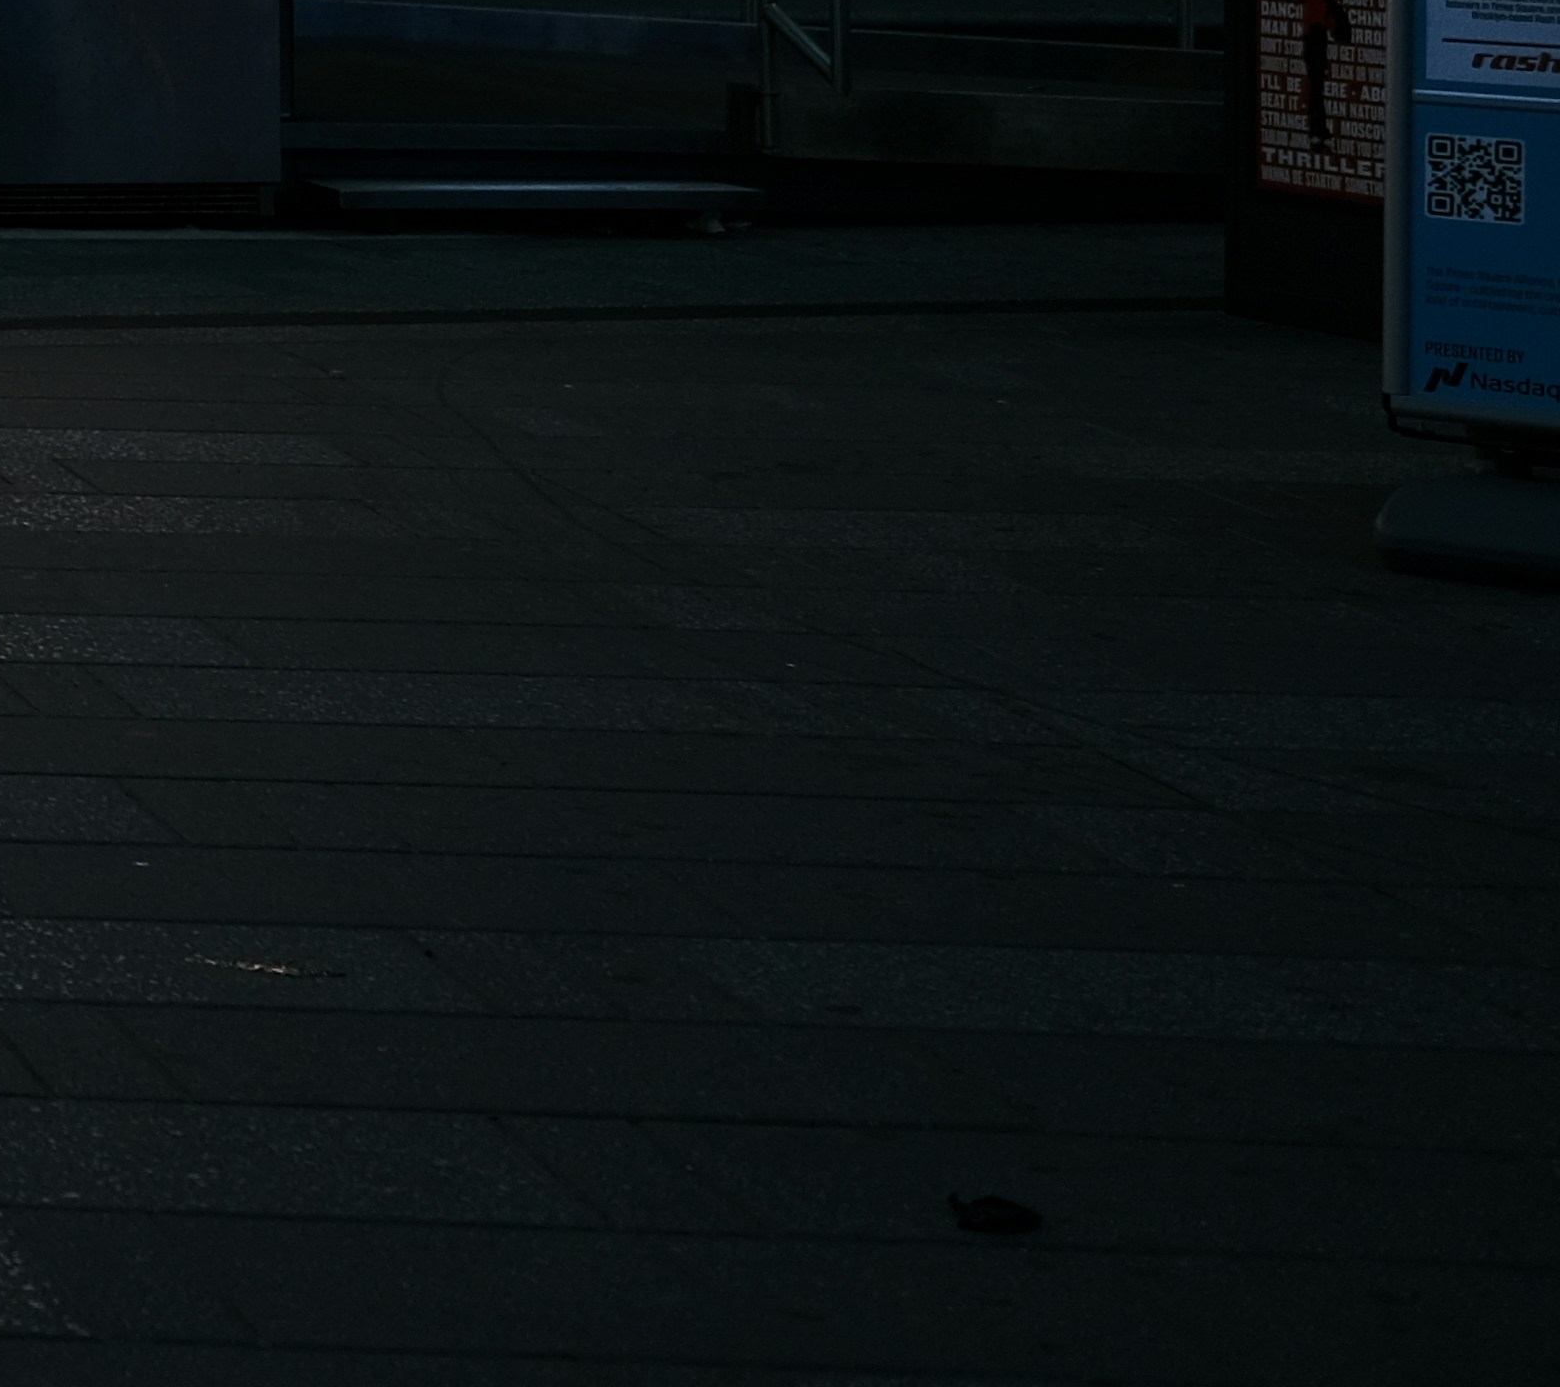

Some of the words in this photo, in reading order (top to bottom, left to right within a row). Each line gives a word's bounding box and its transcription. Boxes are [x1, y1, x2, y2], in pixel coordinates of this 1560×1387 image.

[1287, 76, 1302, 93] BE
[1260, 91, 1286, 109] BEAT
[1288, 94, 1299, 111] IT
[1424, 340, 1503, 363] PRESENTED
[1507, 348, 1525, 364] BY
[1470, 372, 1560, 403] Nasdaq
